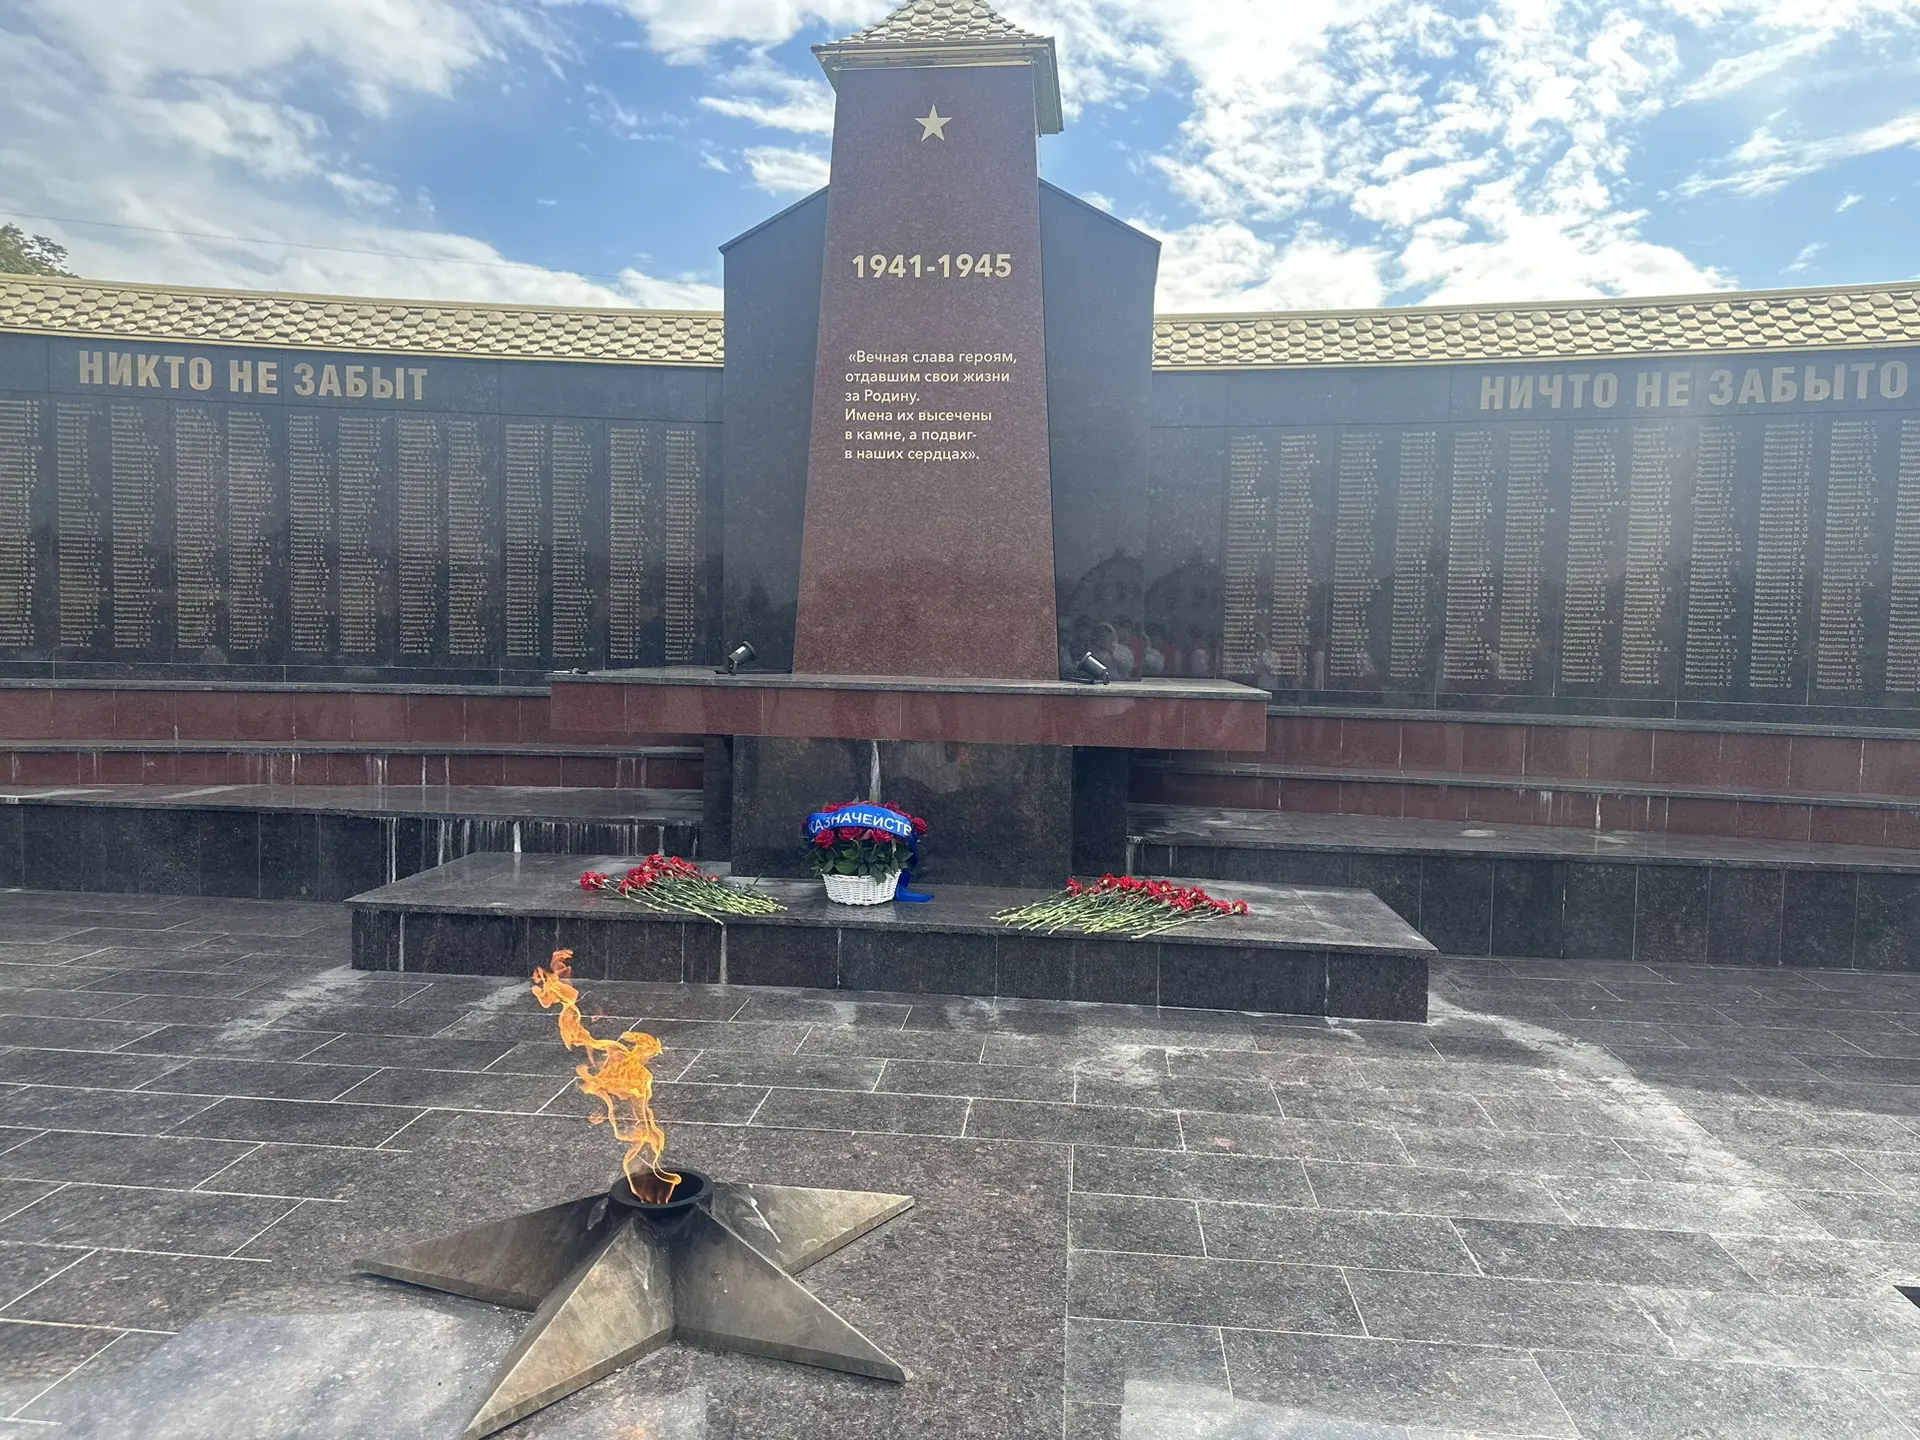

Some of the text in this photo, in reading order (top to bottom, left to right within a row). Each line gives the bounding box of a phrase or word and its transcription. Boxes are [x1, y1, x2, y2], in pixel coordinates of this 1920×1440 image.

[852, 254, 1012, 278] 1941-1945
[848, 350, 1017, 366] «Вечная слава героям,
[79, 350, 428, 400] НИКТО НЕ ЗАБЫТ
[845, 373, 1010, 384] отдавшим свои жизни
[1480, 361, 1908, 410] НИЧТО НЕ ЗАБЫТО
[845, 390, 920, 404] за Родину.
[845, 409, 992, 421] Имена их высечены
[845, 431, 977, 442] в камне, а подвиг-
[844, 450, 980, 462] в наших сердцах».
